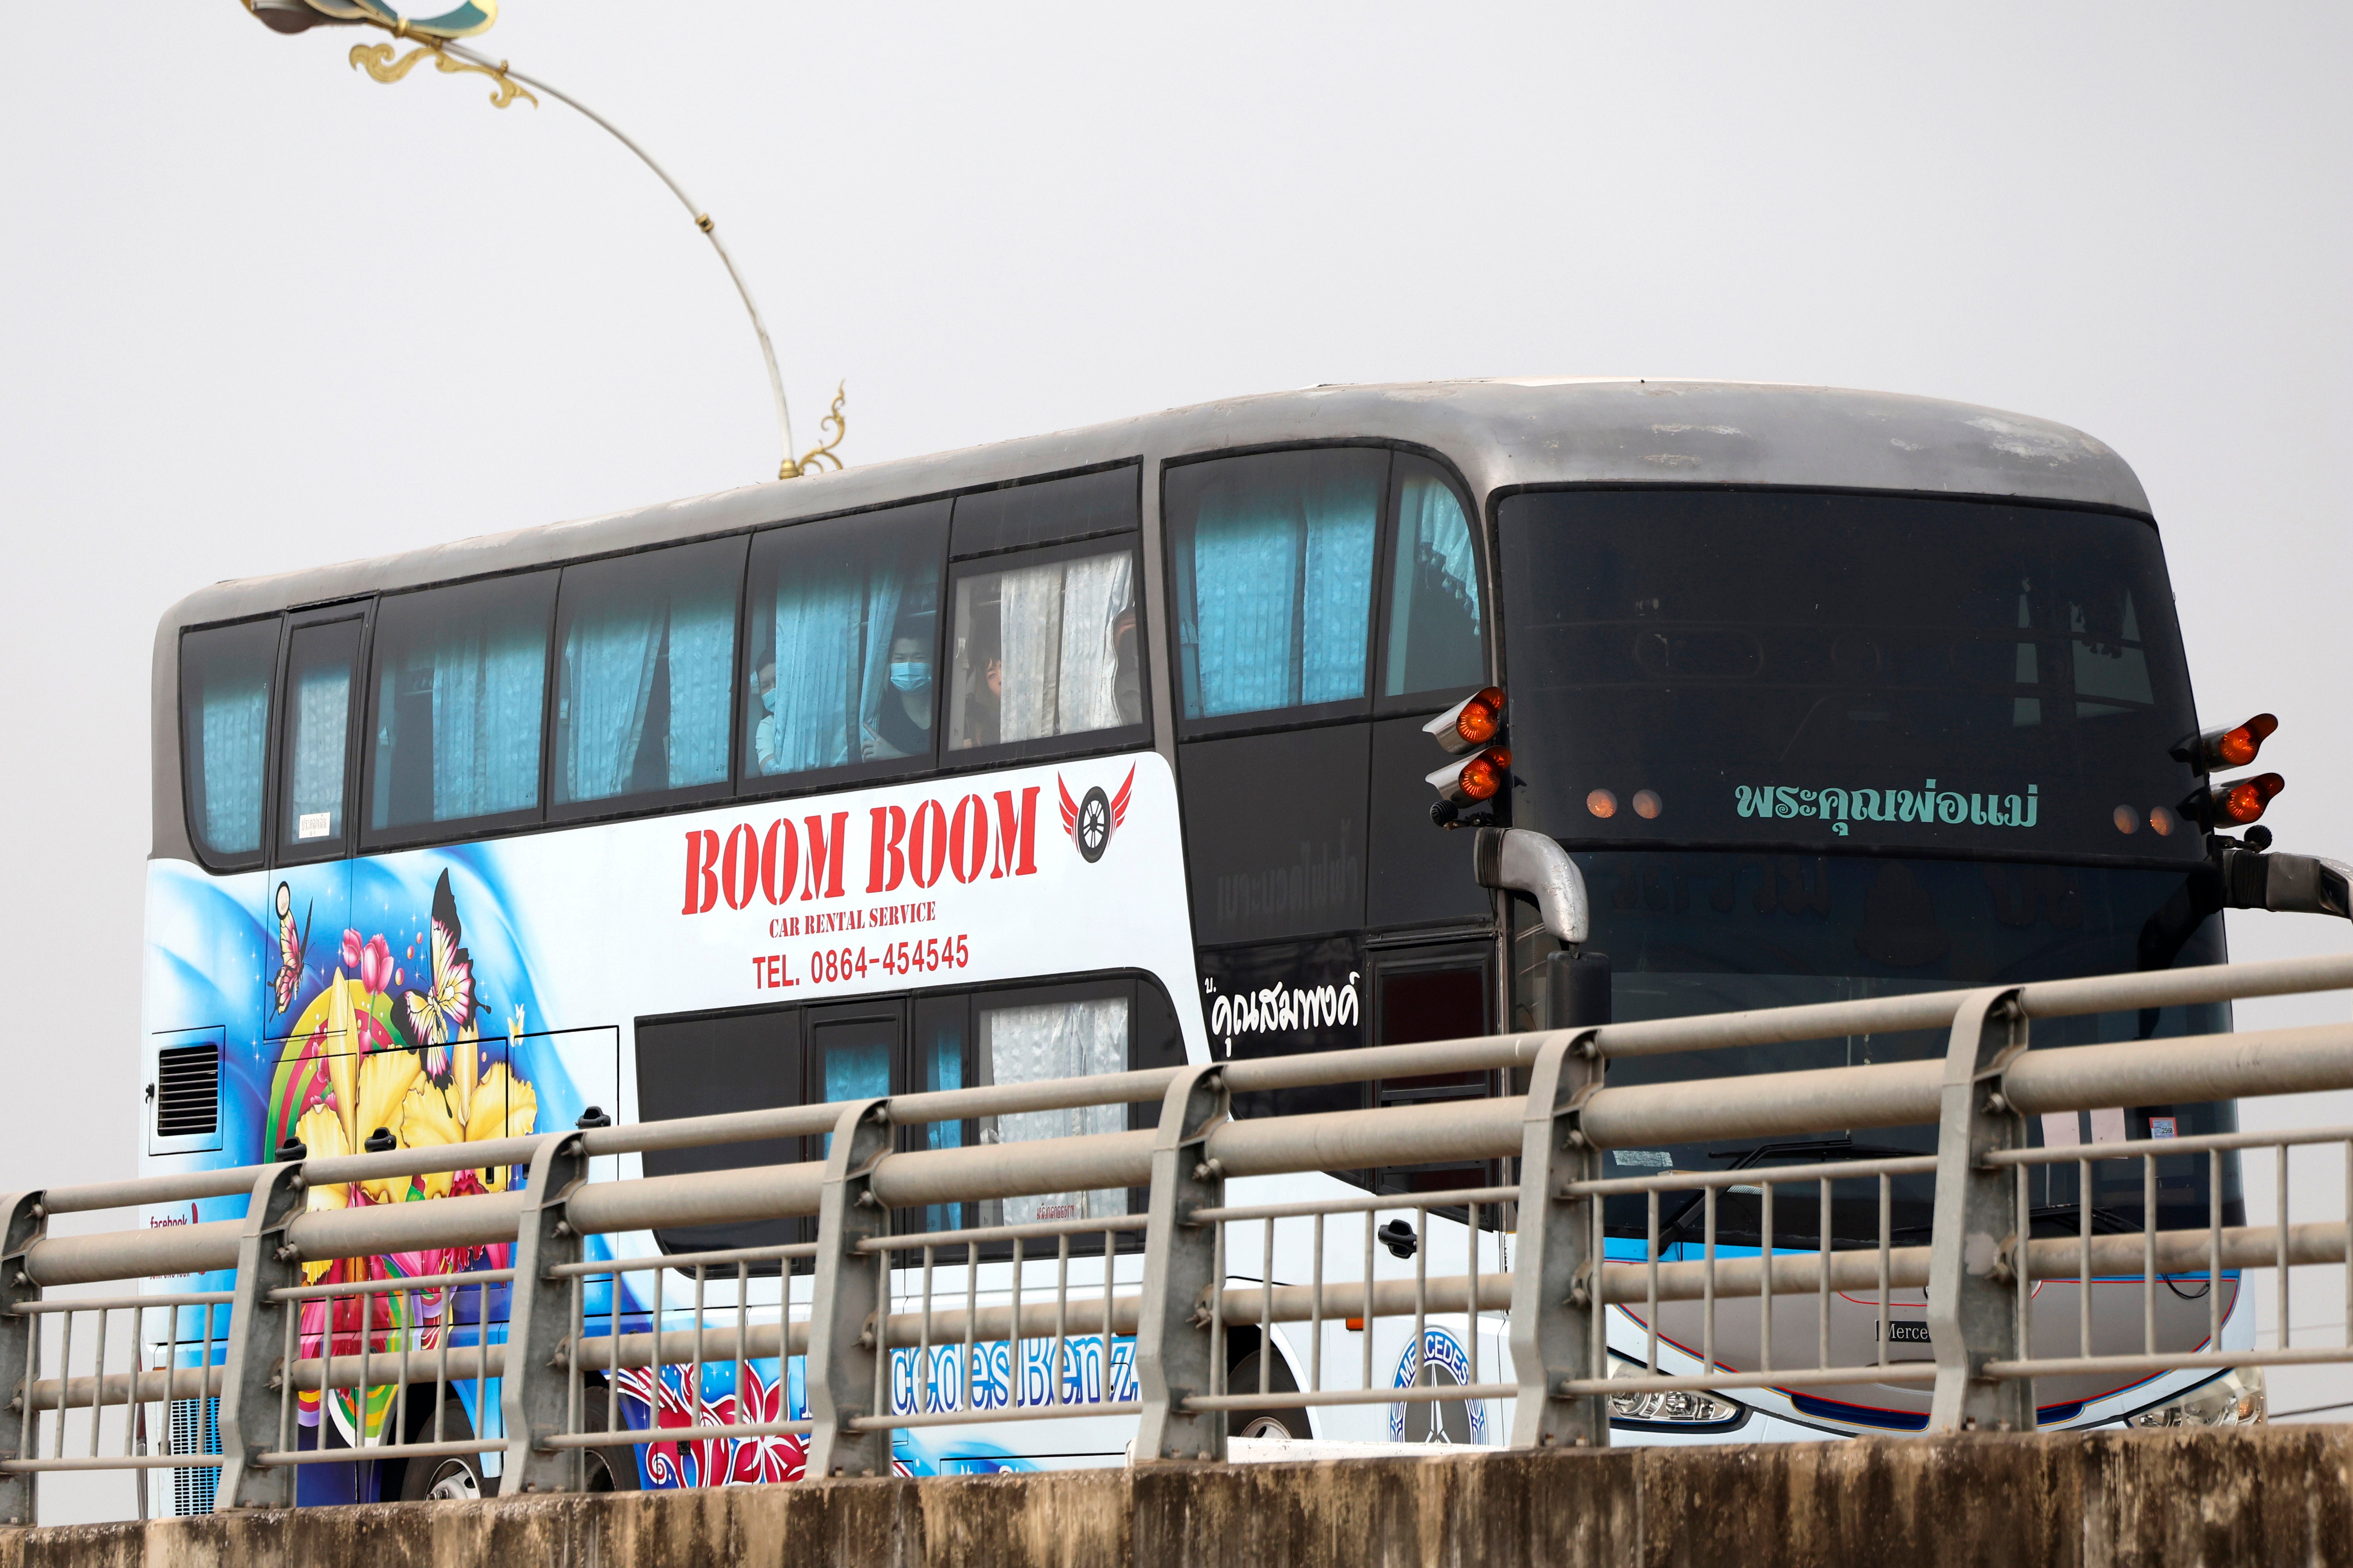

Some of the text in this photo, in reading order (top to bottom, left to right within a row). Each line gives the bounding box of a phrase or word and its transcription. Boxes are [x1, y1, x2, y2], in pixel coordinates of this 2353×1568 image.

[1735, 779, 2038, 836] พระคุณพ่อแม่
[682, 786, 1041, 916] BOOM BOOM
[769, 901, 936, 938] CAR RENTAL SERVICE
[753, 934, 969, 989] TEL. 0864-454545
[1399, 1335, 1469, 1386] MECEDES
